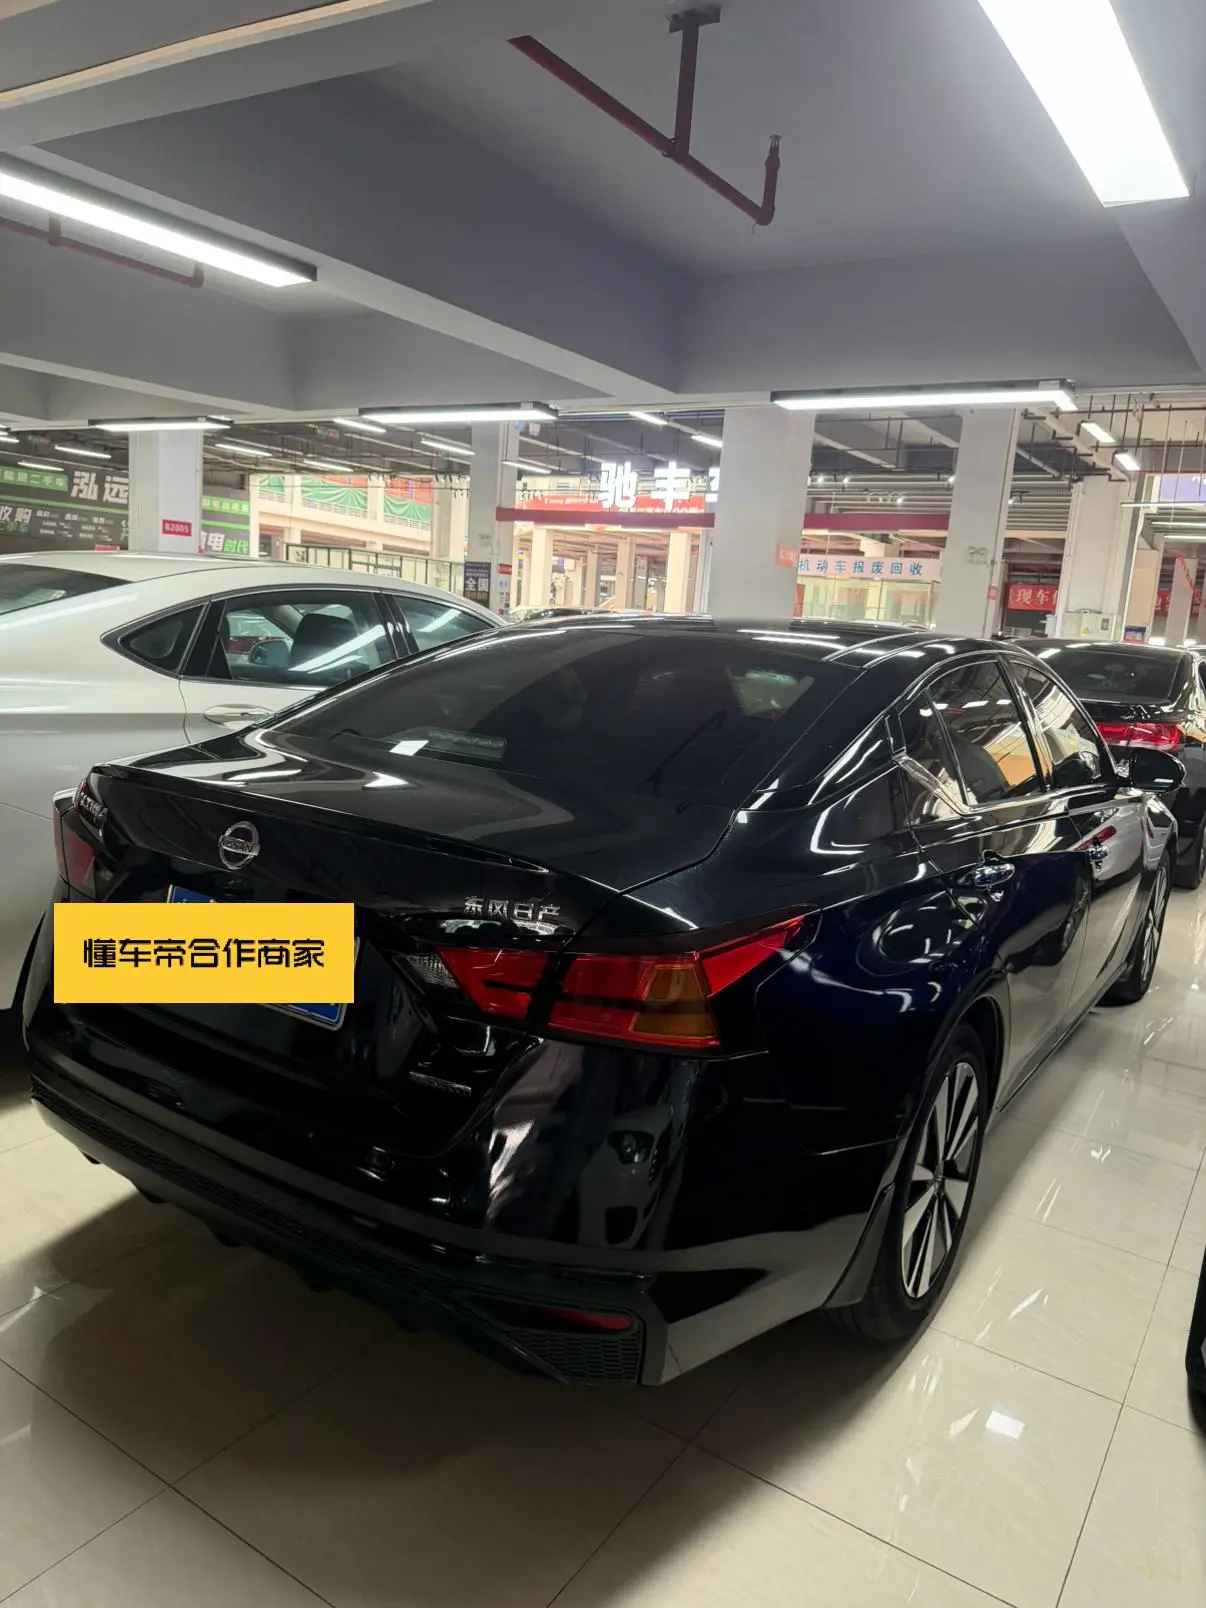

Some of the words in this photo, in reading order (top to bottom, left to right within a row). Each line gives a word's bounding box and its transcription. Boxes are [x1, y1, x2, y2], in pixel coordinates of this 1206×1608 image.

[798, 559, 923, 577] 机动车报废回收
[464, 896, 561, 921] 东风日产
